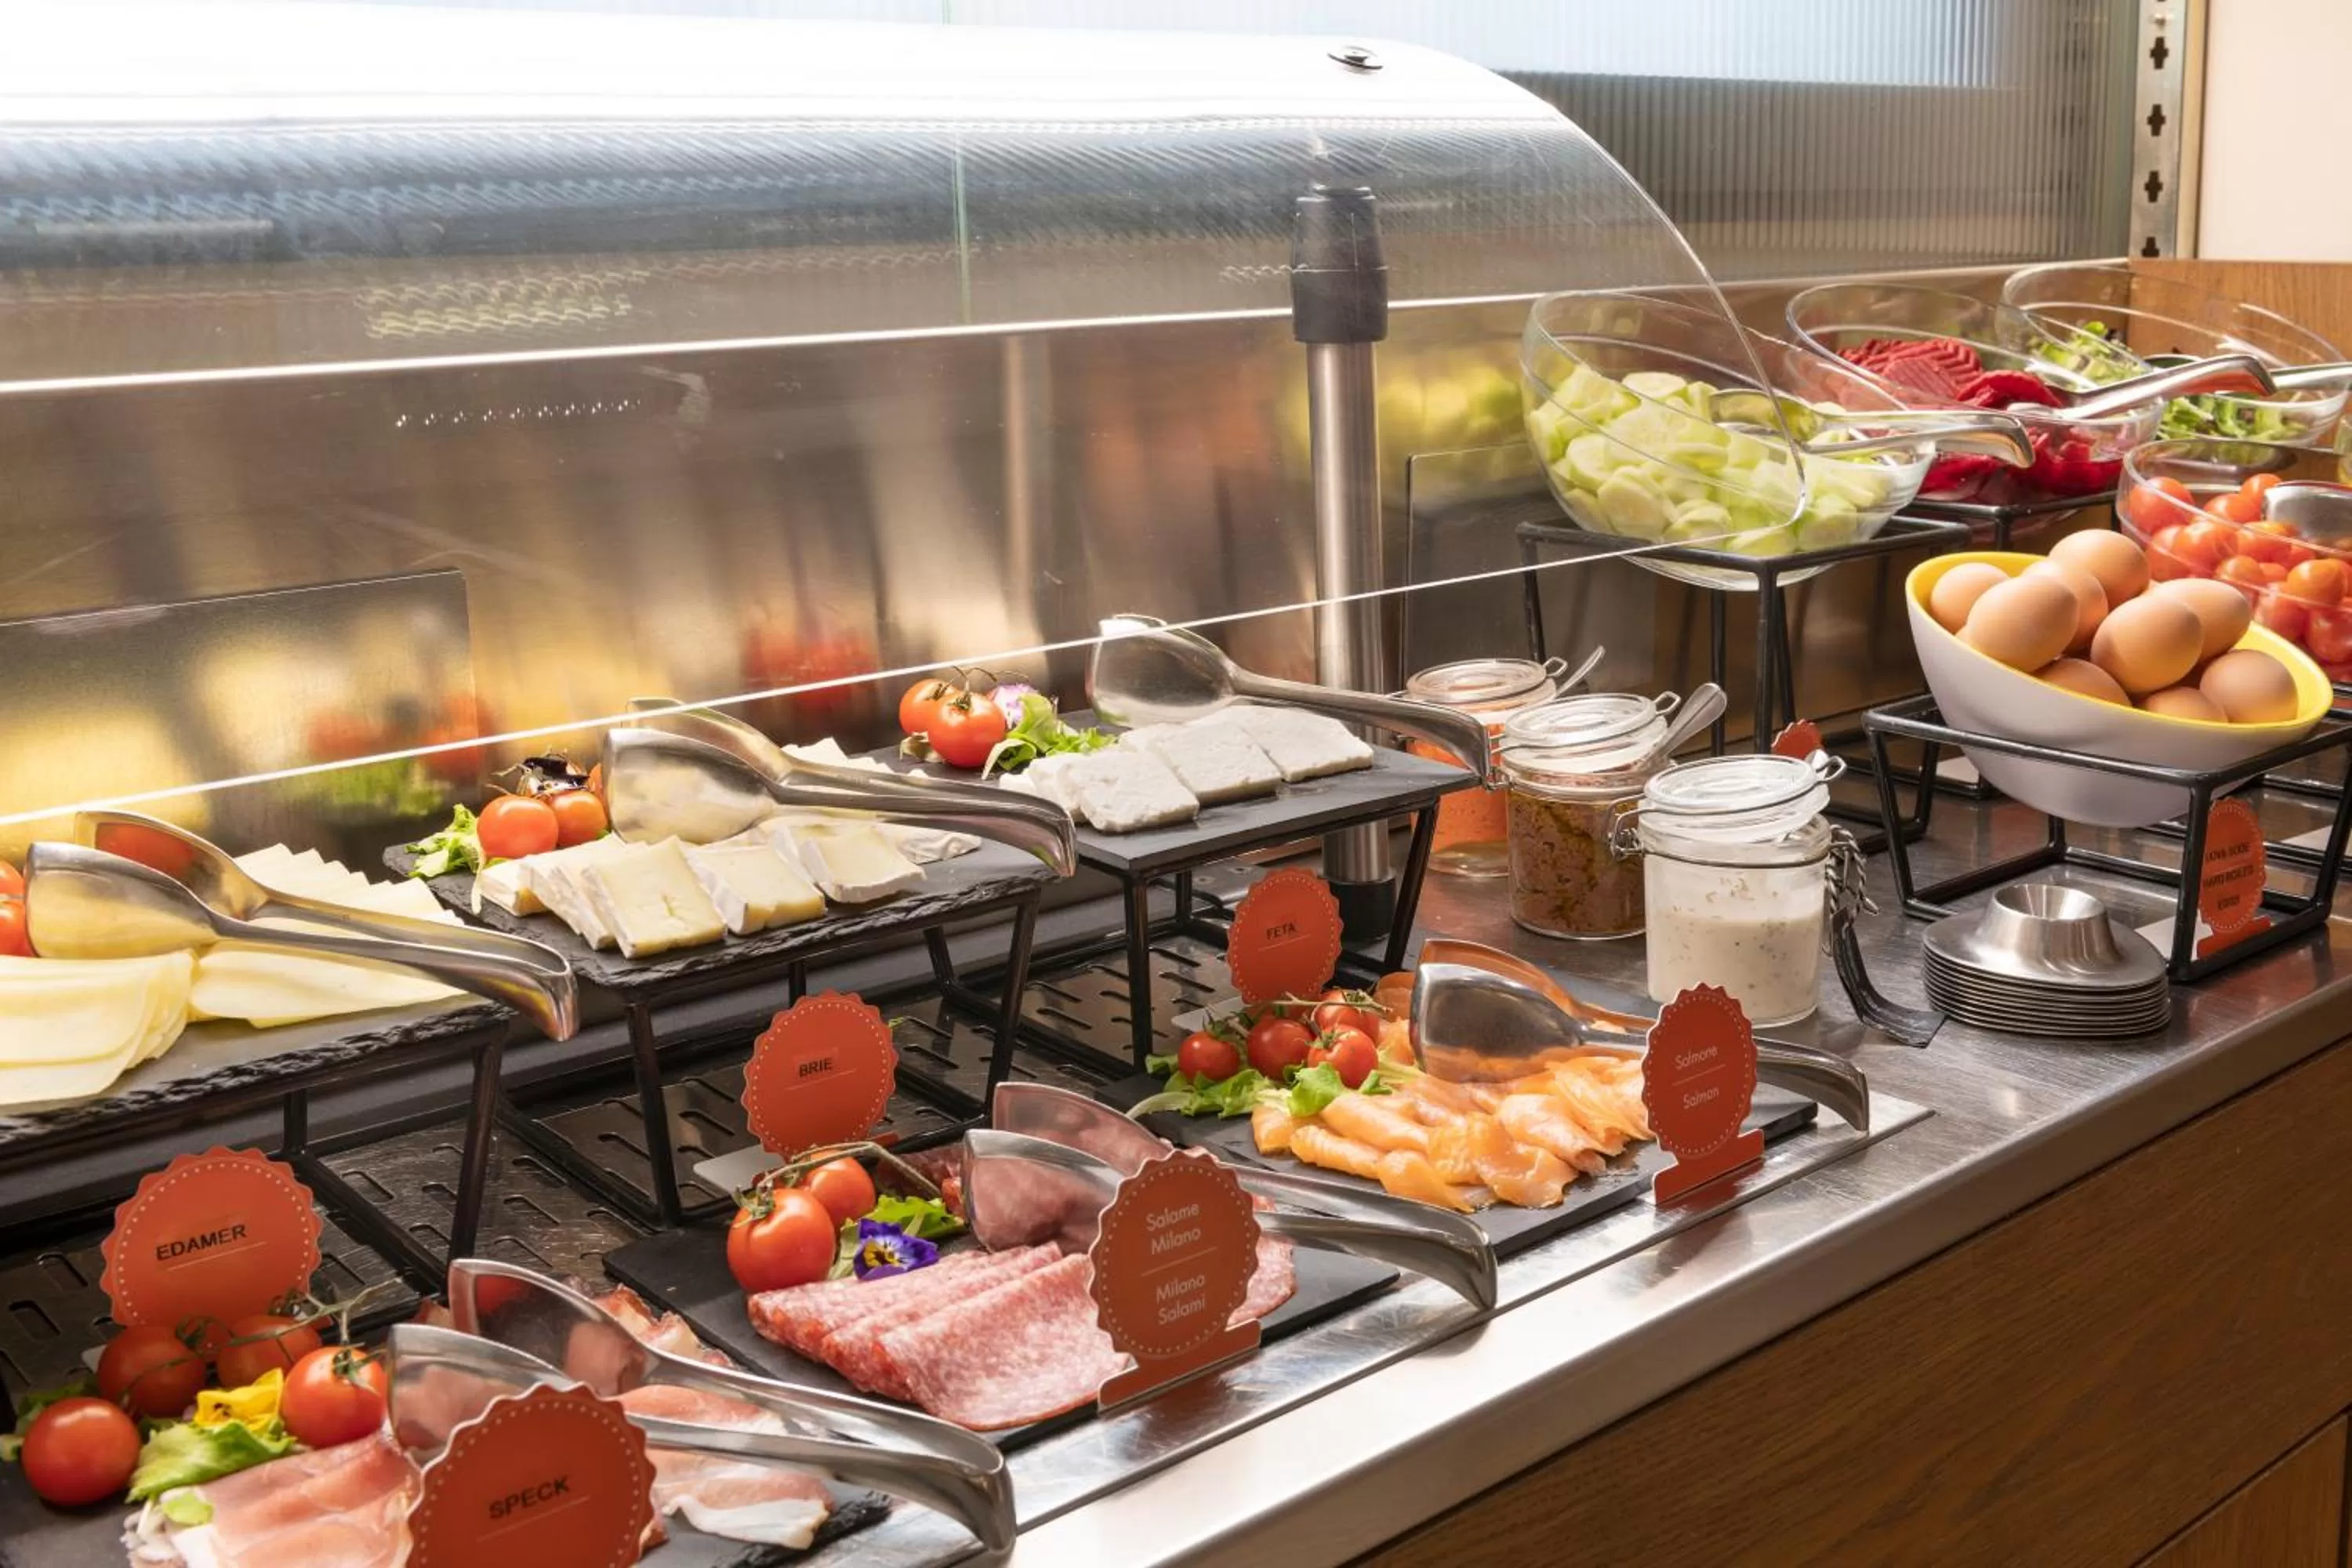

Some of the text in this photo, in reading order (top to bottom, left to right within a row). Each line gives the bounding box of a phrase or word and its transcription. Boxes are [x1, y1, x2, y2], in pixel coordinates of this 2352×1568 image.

[1265, 921, 1297, 940] FETA
[799, 1058, 833, 1078] BRIE
[1675, 1045, 1719, 1070] Salmone
[1682, 1086, 1719, 1109] Salmon
[1145, 1203, 1200, 1232] Salame
[156, 1224, 249, 1261] EDAMER
[1151, 1226, 1202, 1255] Milano
[1156, 1273, 1205, 1304] Milano
[1157, 1293, 1205, 1326] Salami
[488, 1475, 572, 1519] SPECK
